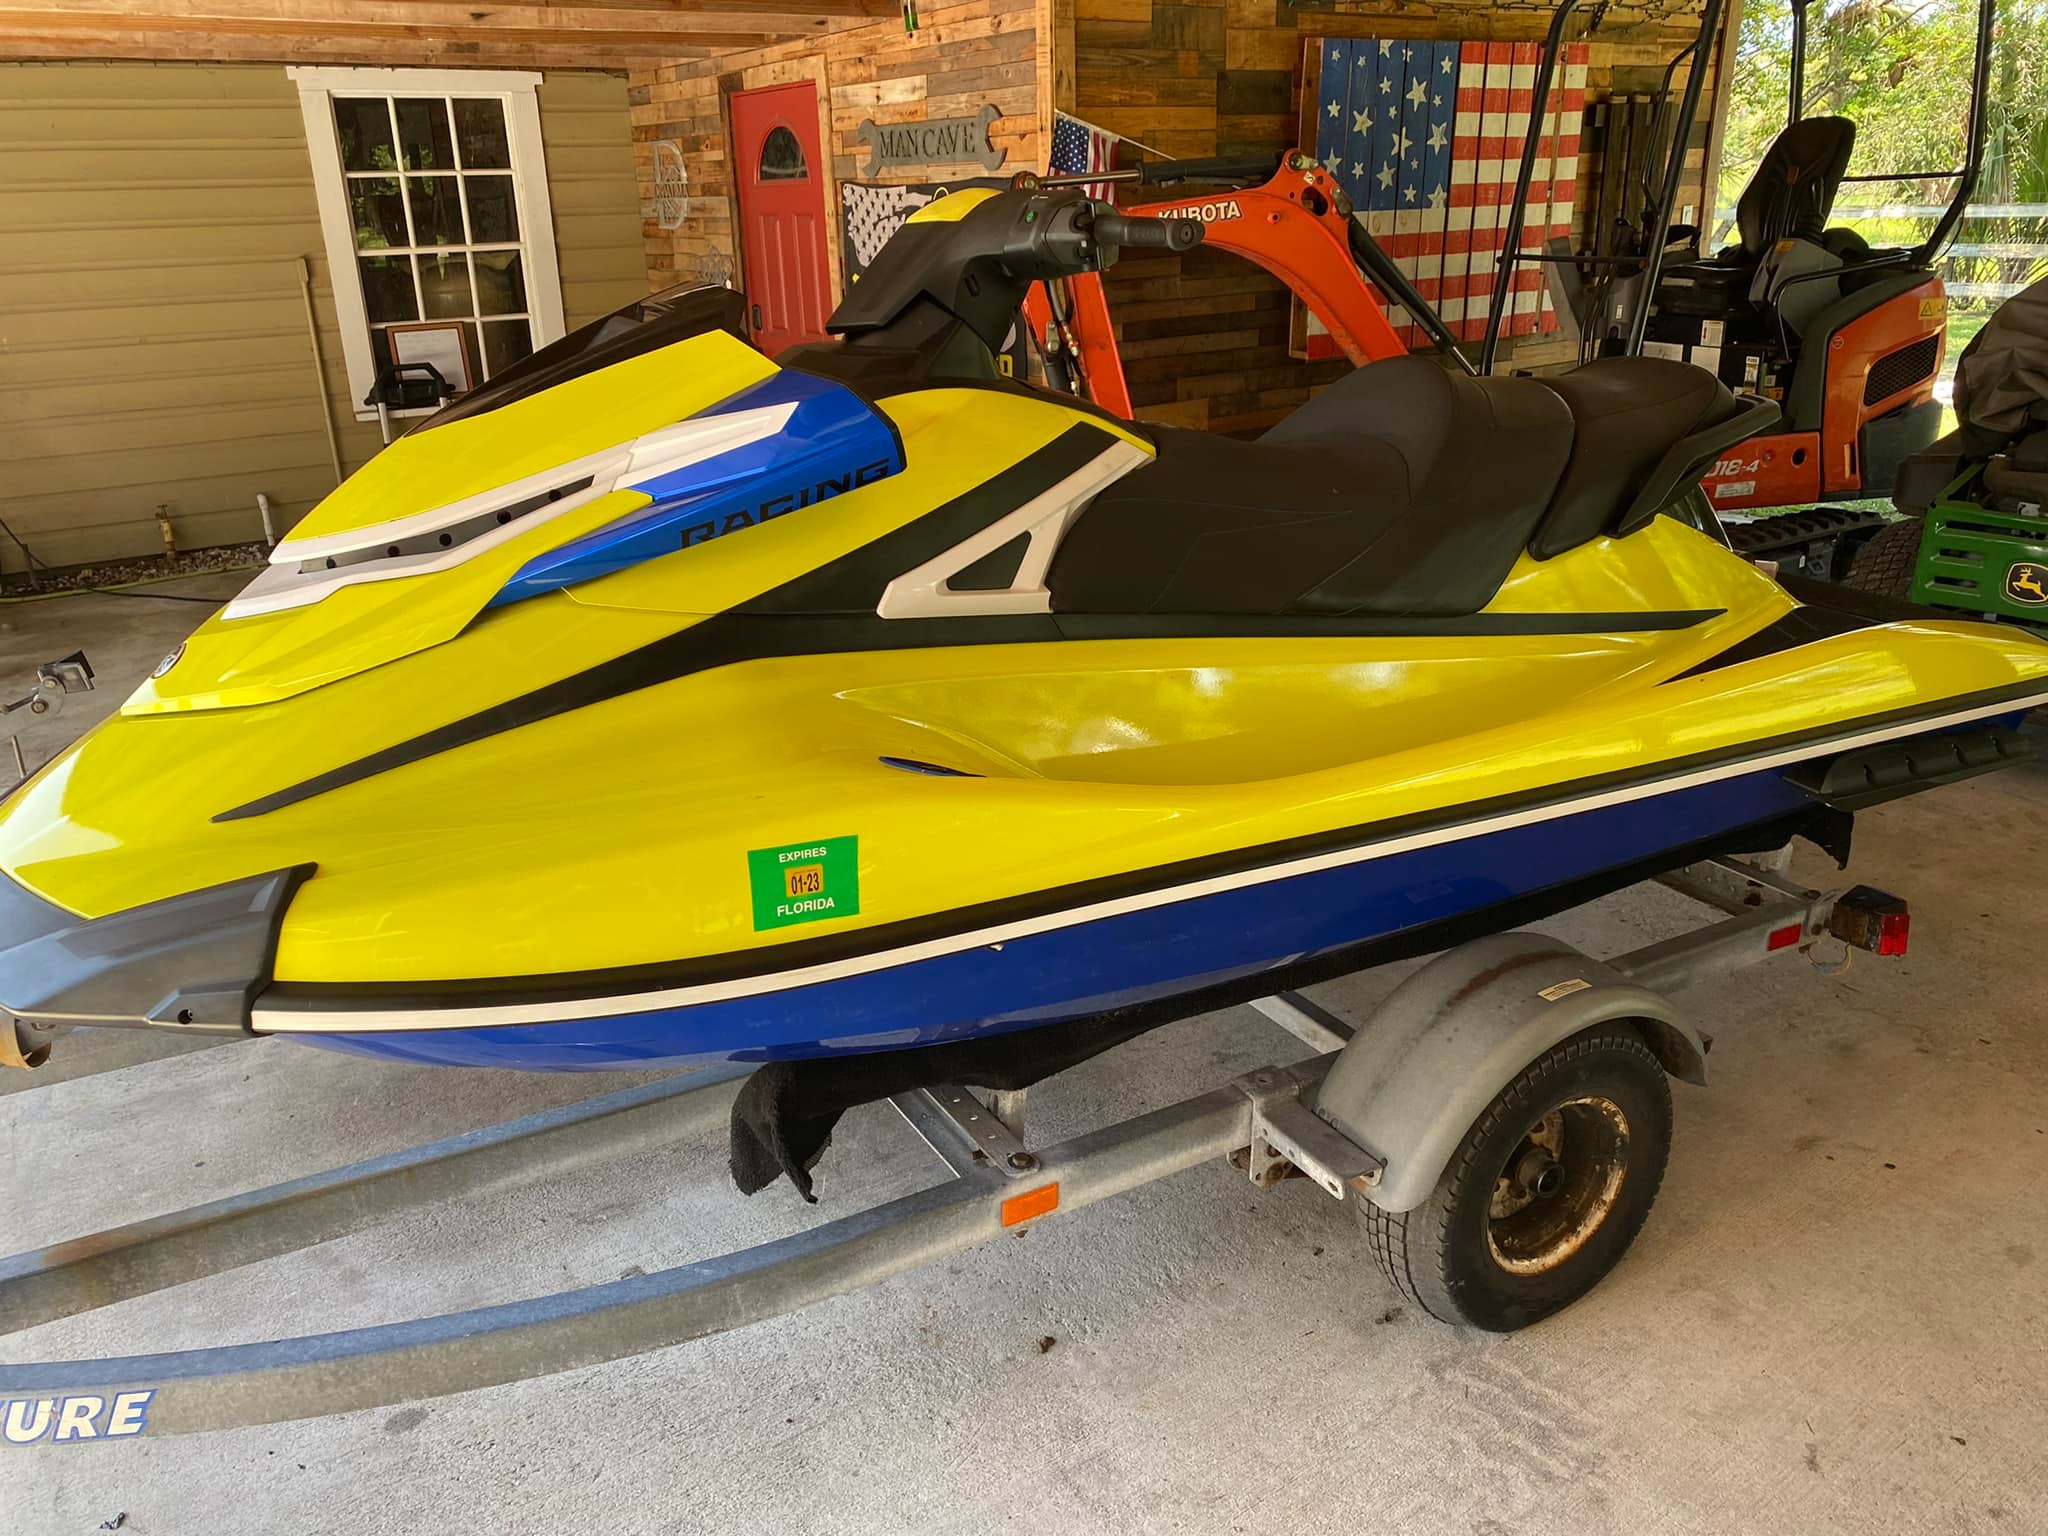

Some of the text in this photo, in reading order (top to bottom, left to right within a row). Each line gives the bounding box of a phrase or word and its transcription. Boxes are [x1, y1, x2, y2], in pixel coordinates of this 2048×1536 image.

[880, 121, 976, 159] MAN CAVE
[680, 457, 889, 550] RACING
[778, 846, 828, 863] EXPIRES
[791, 872, 820, 895] 01-23
[776, 896, 836, 917] FLORIDA
